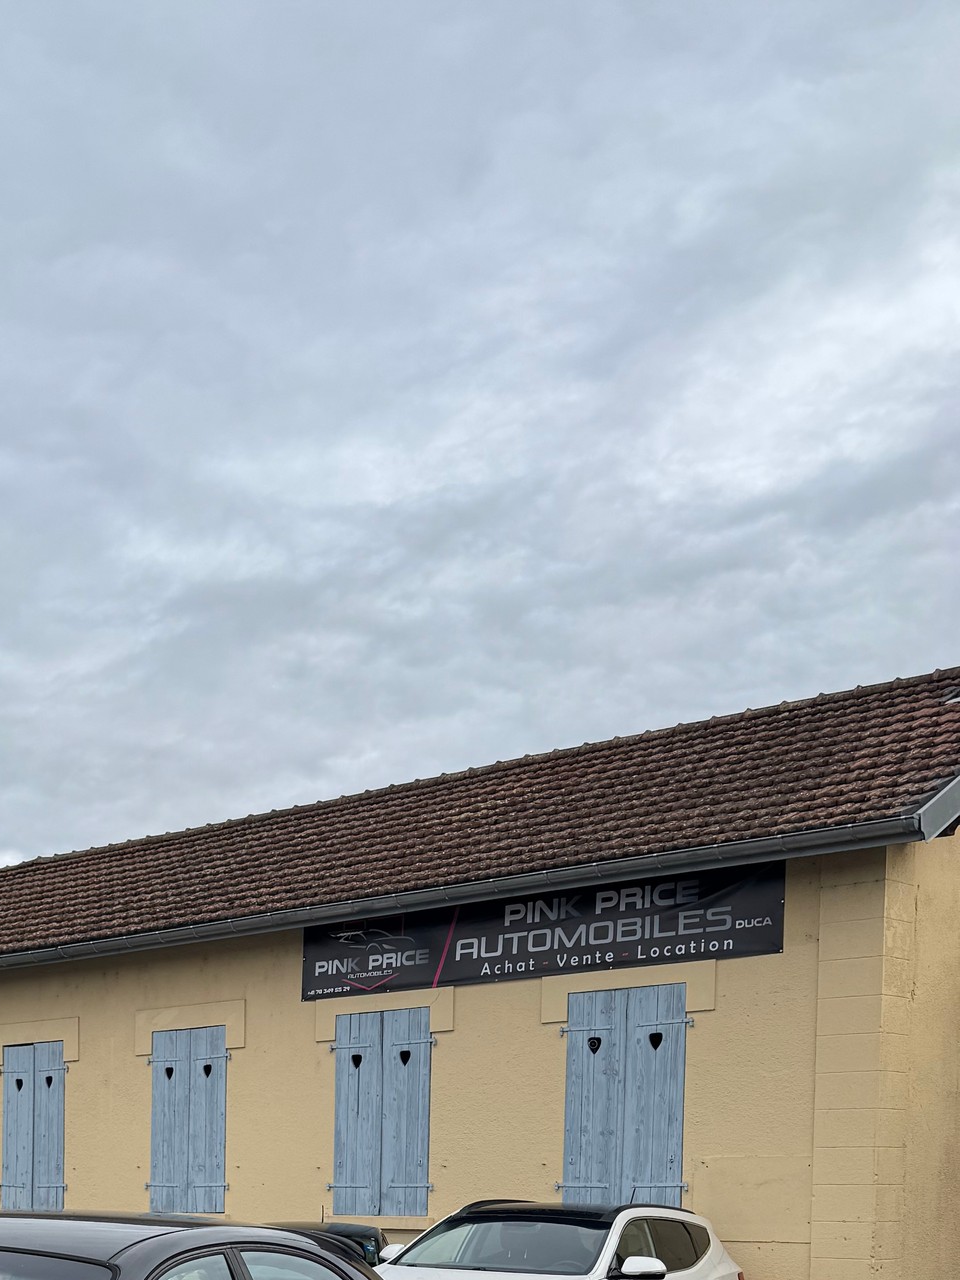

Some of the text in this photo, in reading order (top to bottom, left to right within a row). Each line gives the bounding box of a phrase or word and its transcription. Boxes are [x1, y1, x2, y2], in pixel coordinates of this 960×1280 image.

[504, 879, 699, 927] PINK PRICE
[455, 905, 773, 961] AUTOMOBILES DUCA
[314, 948, 430, 977] PINK PRICE
[347, 969, 393, 979] AUTOMOBILES
[480, 958, 535, 976] Achat
[556, 950, 614, 967] Vente
[637, 938, 734, 959] Location
